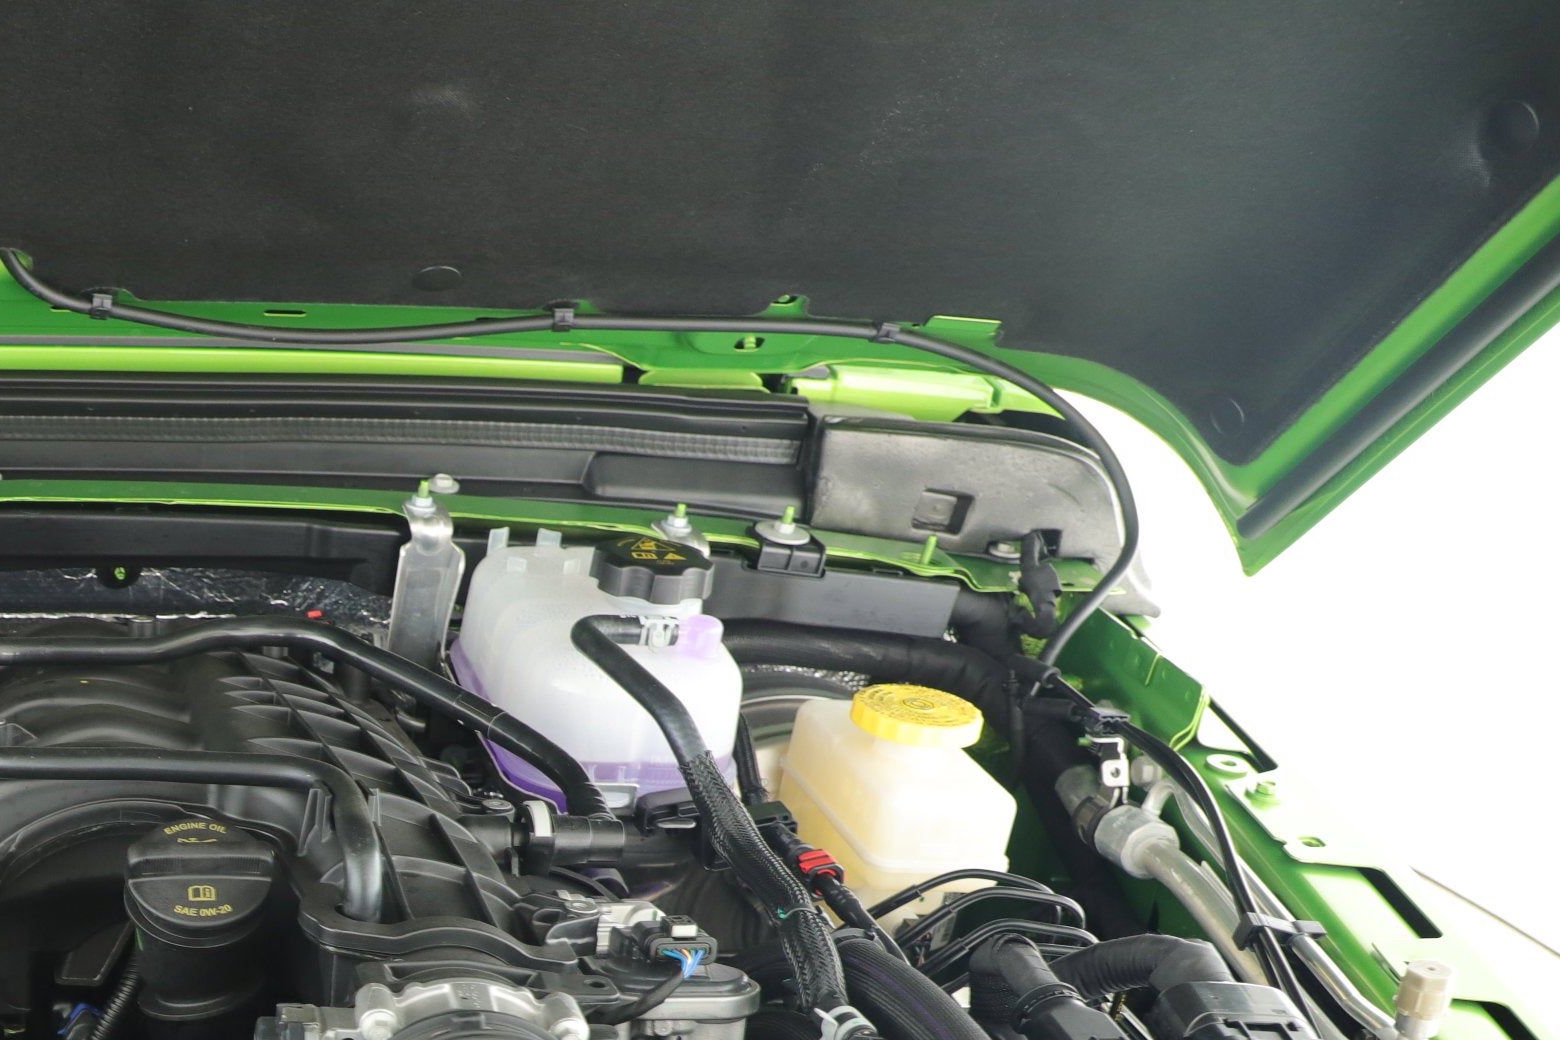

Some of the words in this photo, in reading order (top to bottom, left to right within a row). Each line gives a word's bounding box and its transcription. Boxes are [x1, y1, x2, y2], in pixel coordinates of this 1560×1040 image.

[163, 822, 207, 834] ENGINE
[208, 823, 227, 834] OIL
[173, 904, 198, 917] SAE
[199, 904, 233, 917] 0W-20
